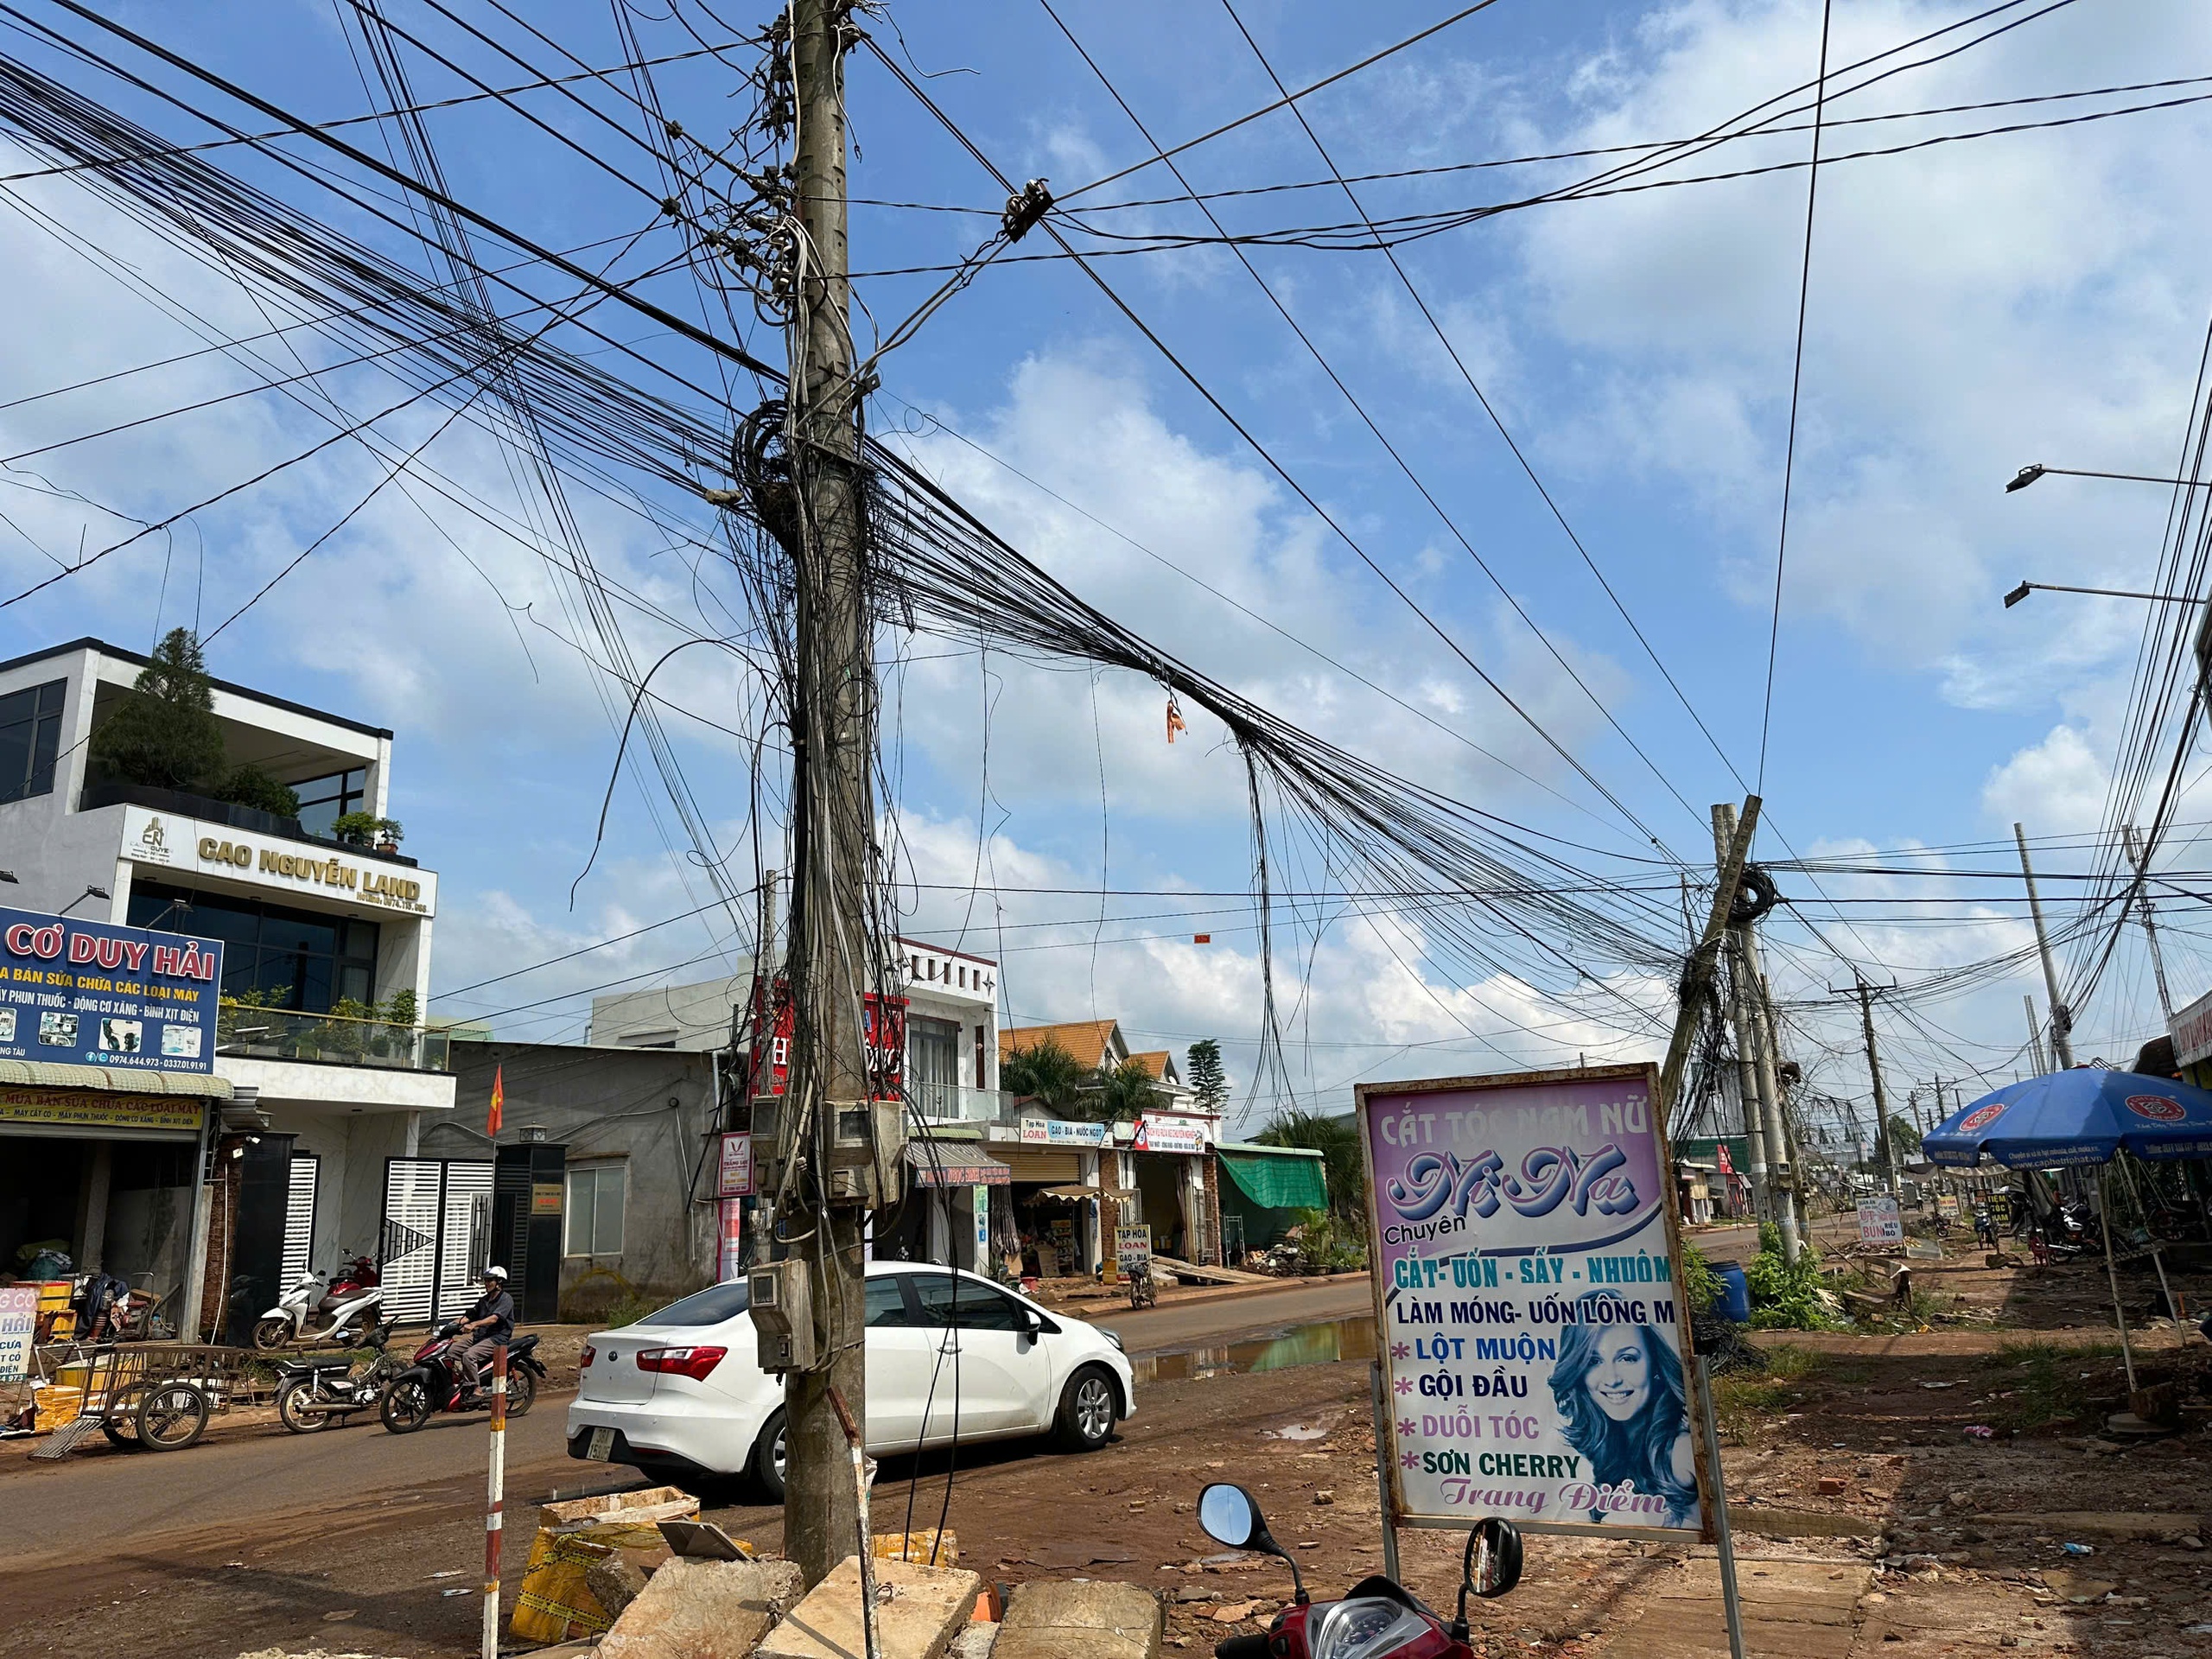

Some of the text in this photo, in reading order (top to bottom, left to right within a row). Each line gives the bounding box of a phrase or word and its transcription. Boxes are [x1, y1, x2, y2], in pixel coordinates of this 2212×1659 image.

[199, 837, 252, 866] CAO
[362, 871, 421, 899] LAND
[5, 923, 215, 980] CƠ DUY HẢI
[13, 967, 42, 982] BÁN
[46, 969, 73, 987] SỬA
[77, 974, 112, 991] CHỮA
[115, 979, 141, 995] CÁC
[143, 984, 170, 1001] LOẠI
[173, 986, 200, 1002] MÁY
[9, 990, 35, 1005] PHUN
[36, 991, 66, 1008] THUỐC
[73, 995, 98, 1013] ĐỘNG
[99, 999, 112, 1013] CƠ
[113, 1000, 137, 1016] XĂNG
[144, 1004, 163, 1020] BÌNH
[165, 1007, 179, 1022] XỊT
[181, 1008, 200, 1024] ĐIỆN
[13, 1046, 26, 1057] TÀU
[110, 1054, 159, 1067] 0974.644.973
[163, 1058, 207, 1071] 0337.01.91.91
[5, 1094, 32, 1105] MUA
[1022, 1129, 1047, 1140] LOAN
[1381, 1102, 1436, 1147] CẮT
[1599, 1095, 1649, 1135] NỮ
[1384, 1216, 1467, 1246] Chuyên
[1451, 1247, 1498, 1288] UỐN
[1519, 1245, 1564, 1284] SẤY
[2, 1313, 33, 1334] HẢI
[1396, 1296, 1444, 1325] LÀM
[1529, 1292, 1577, 1325] UỐN
[1582, 1294, 1648, 1325] LÔNG
[1415, 1332, 1556, 1365] LỘT MUỘN
[1419, 1365, 1529, 1402] GỘI ĐẦU
[1422, 1403, 1540, 1440] DUỖI TÓC
[1422, 1448, 1581, 1479] SƠN CHERRY
[1440, 1478, 1670, 1515] Trang Điểm
